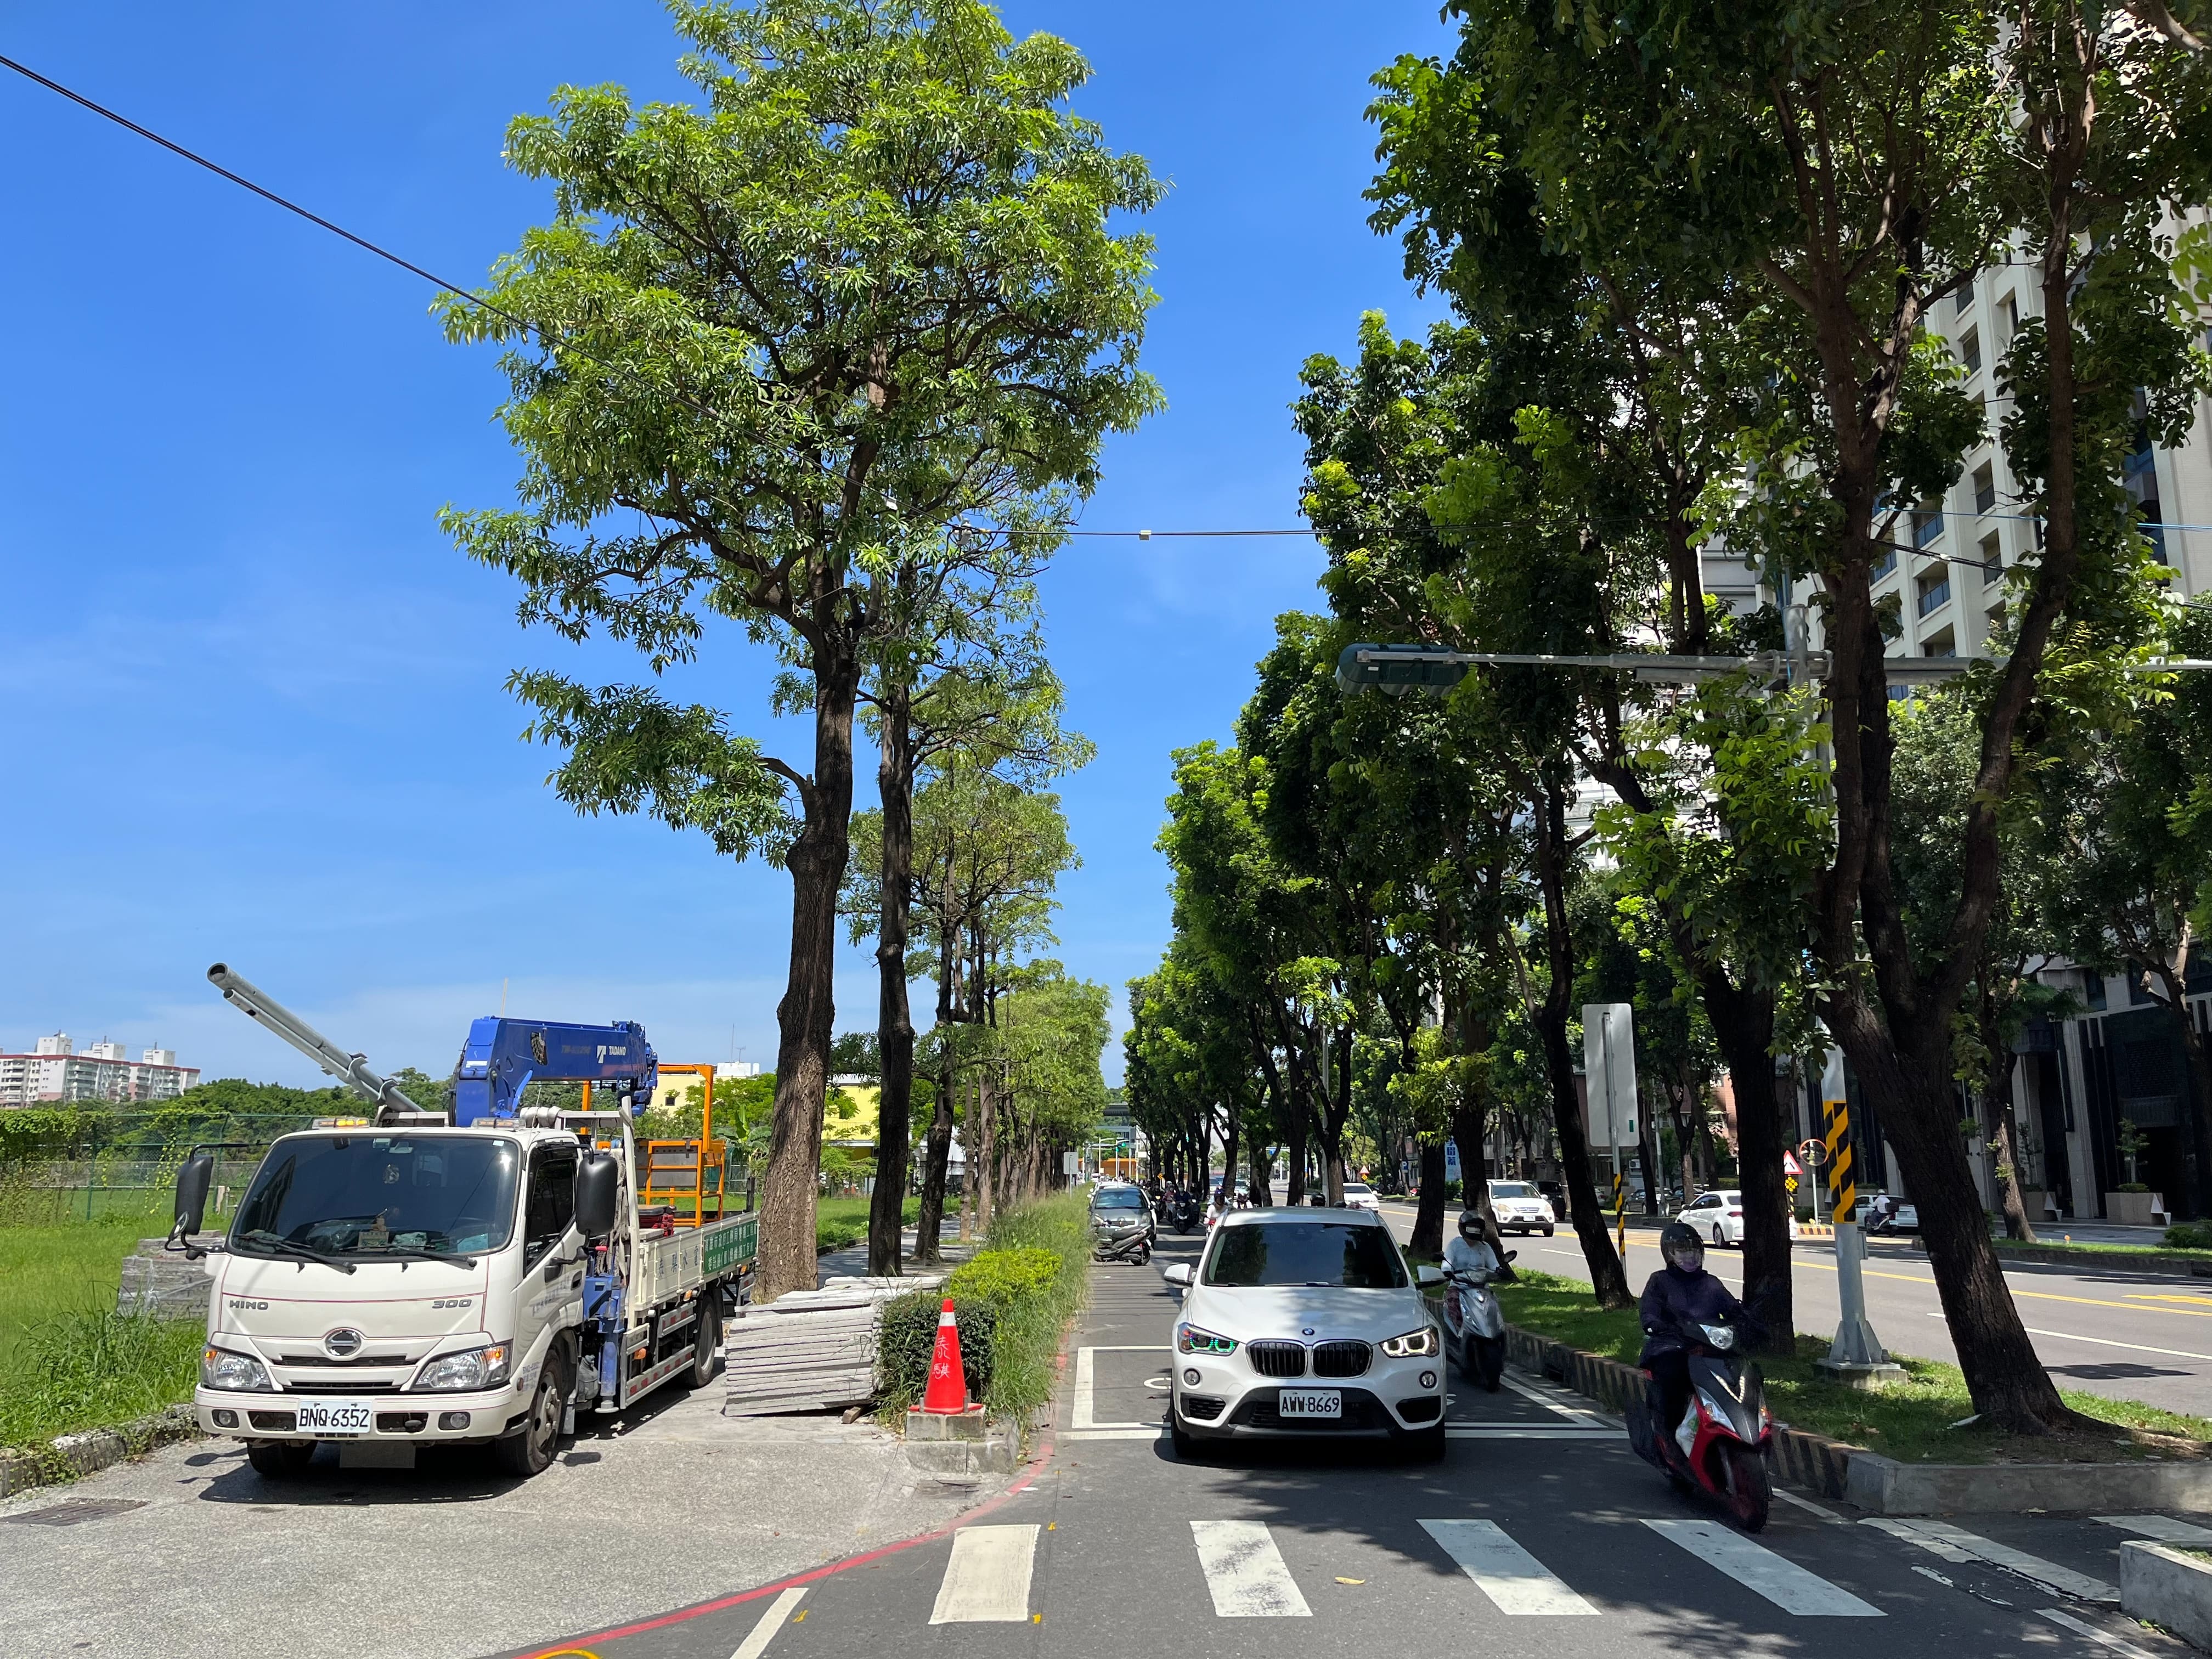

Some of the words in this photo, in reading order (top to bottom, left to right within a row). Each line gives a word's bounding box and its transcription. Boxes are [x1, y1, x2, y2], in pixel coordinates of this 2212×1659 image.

[609, 1045, 627, 1056] TADANO
[229, 1300, 269, 1310] HINO
[432, 1299, 472, 1309] 300
[1282, 1396, 1340, 1413] AWW-8669
[298, 1408, 369, 1427] BNQ-6352
